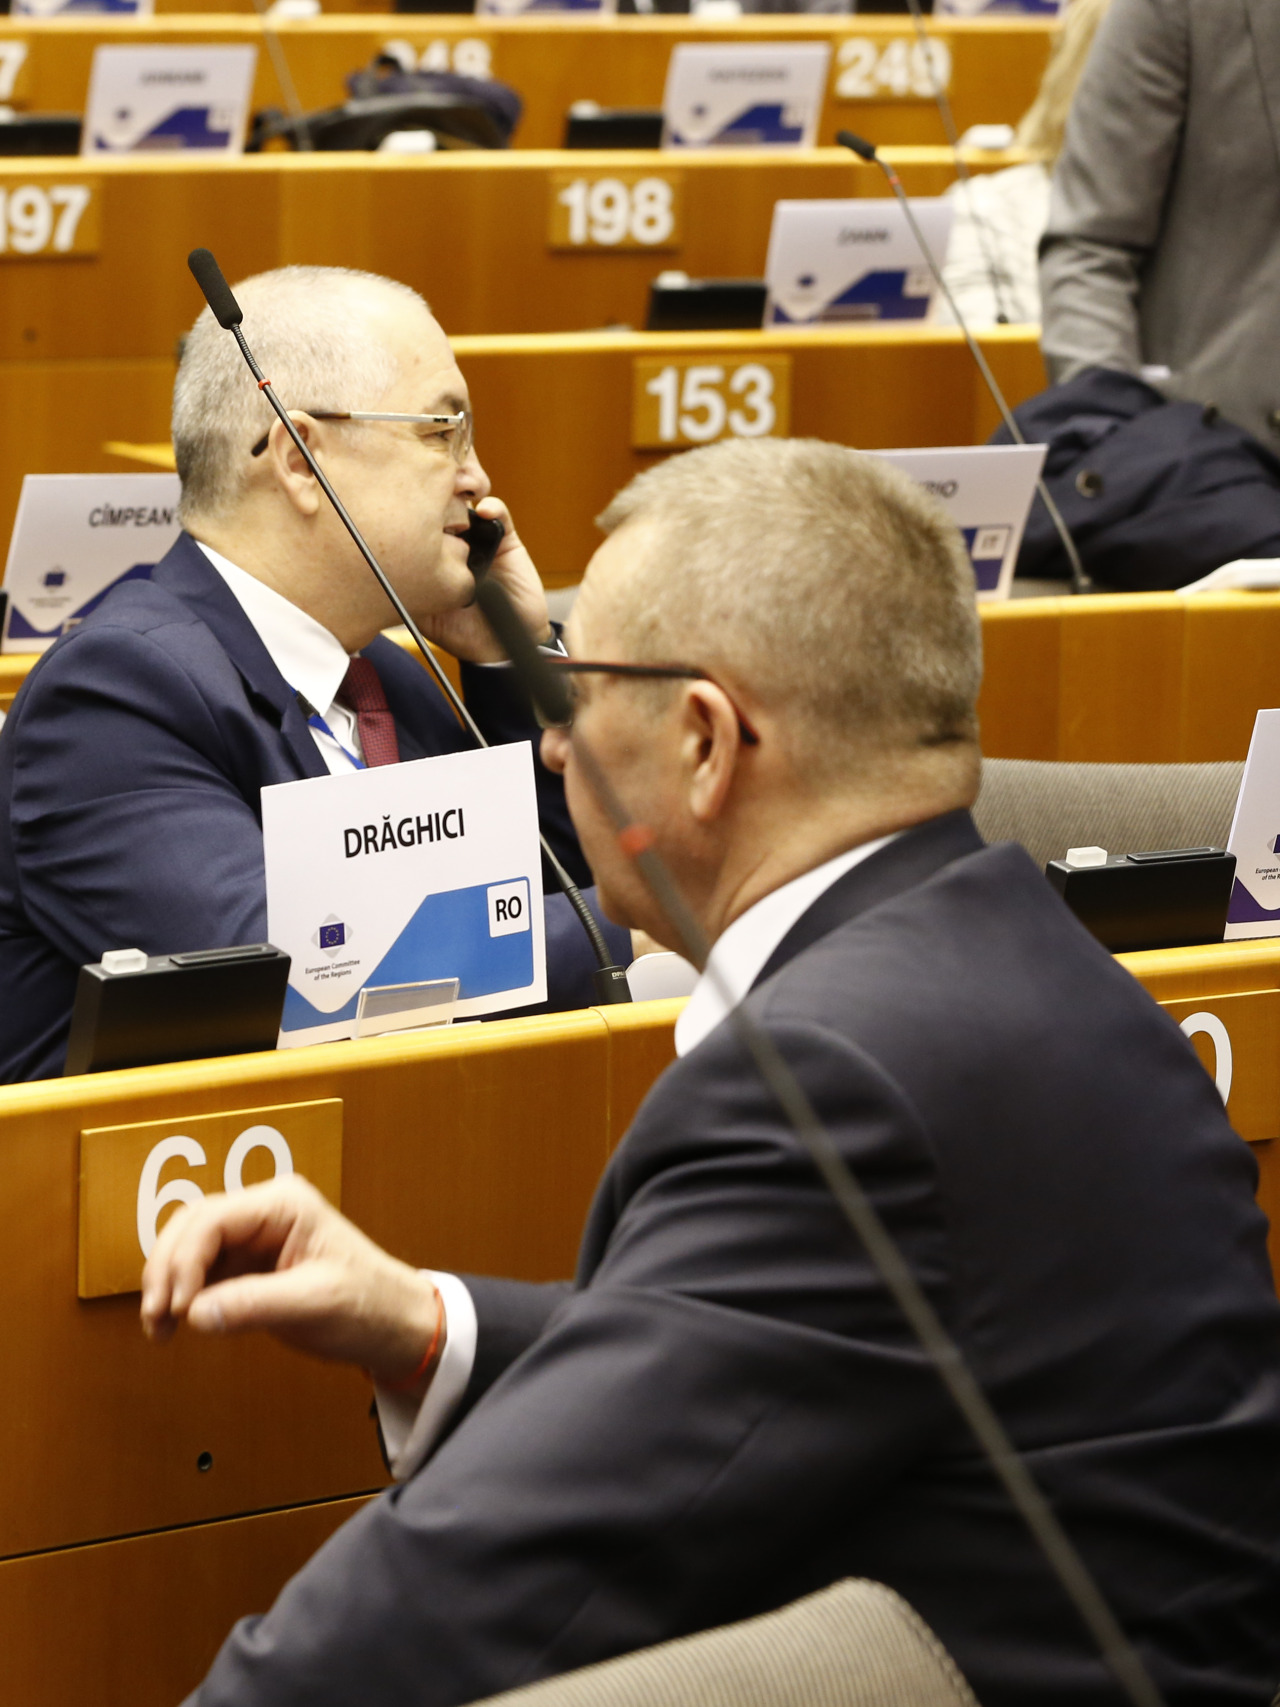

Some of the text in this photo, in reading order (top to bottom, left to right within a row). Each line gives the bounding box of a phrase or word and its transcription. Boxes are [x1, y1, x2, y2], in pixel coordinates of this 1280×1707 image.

[836, 37, 951, 97] 249
[559, 177, 674, 245] 198
[647, 364, 775, 441] 153
[343, 808, 466, 859] DRĂGHICI
[495, 896, 522, 922] RO
[305, 965, 330, 975] European
